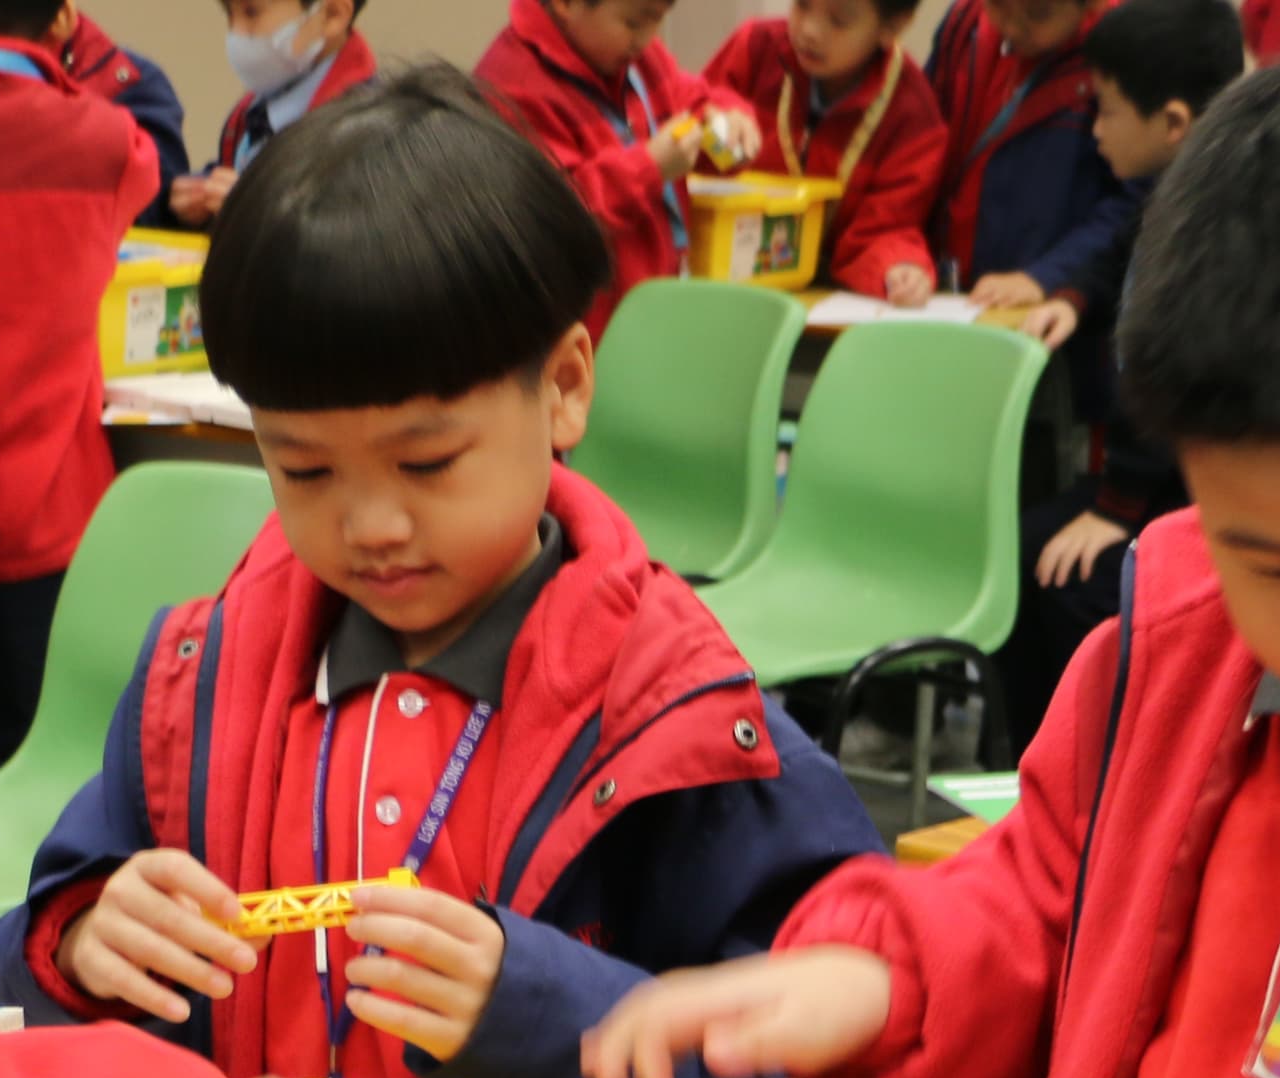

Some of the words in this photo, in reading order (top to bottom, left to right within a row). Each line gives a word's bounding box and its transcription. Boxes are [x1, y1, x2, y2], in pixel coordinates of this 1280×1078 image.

[464, 713, 485, 742] LEE
[456, 738, 473, 760] KU
[440, 755, 465, 792] TONG
[430, 790, 450, 816] SIN
[418, 813, 439, 844] LOK
